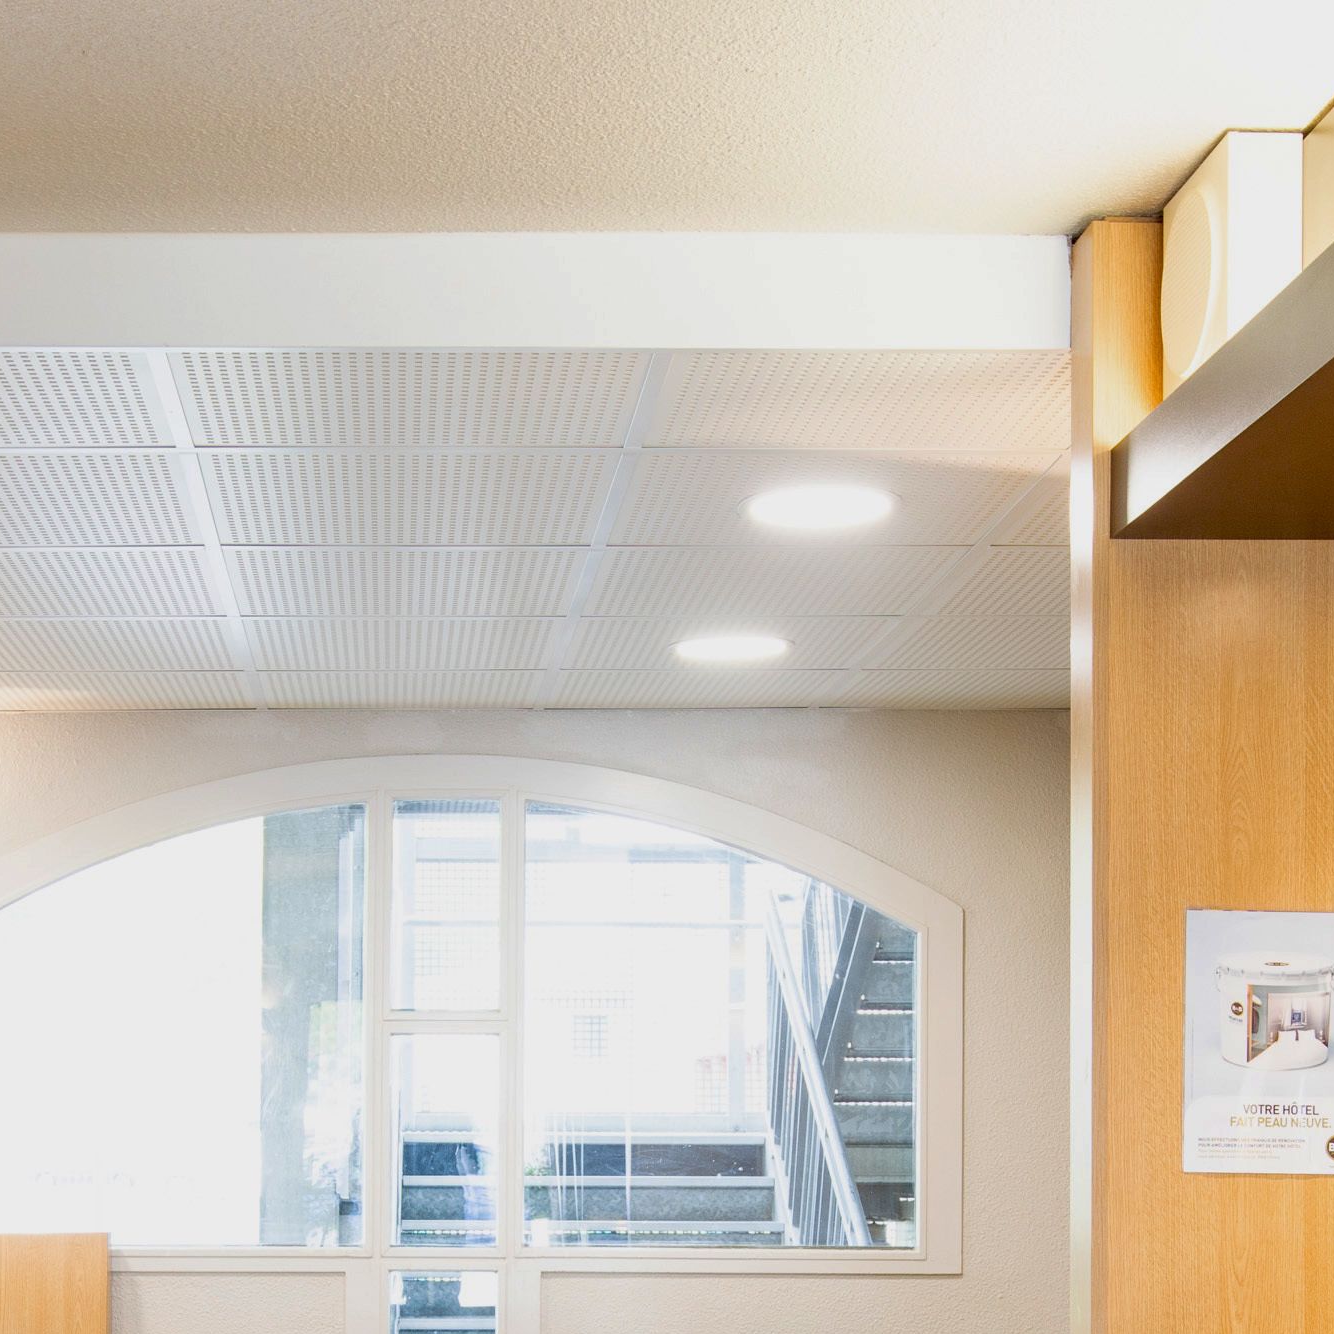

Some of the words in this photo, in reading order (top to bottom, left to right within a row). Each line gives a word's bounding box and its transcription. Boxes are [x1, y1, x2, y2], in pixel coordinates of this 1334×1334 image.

[1243, 1104, 1280, 1115] VOTRE
[1282, 1100, 1319, 1116] HÔTEL
[1230, 1116, 1256, 1128] FAIT
[1257, 1117, 1288, 1128] PEAU
[1290, 1117, 1332, 1129] NEUVE.
